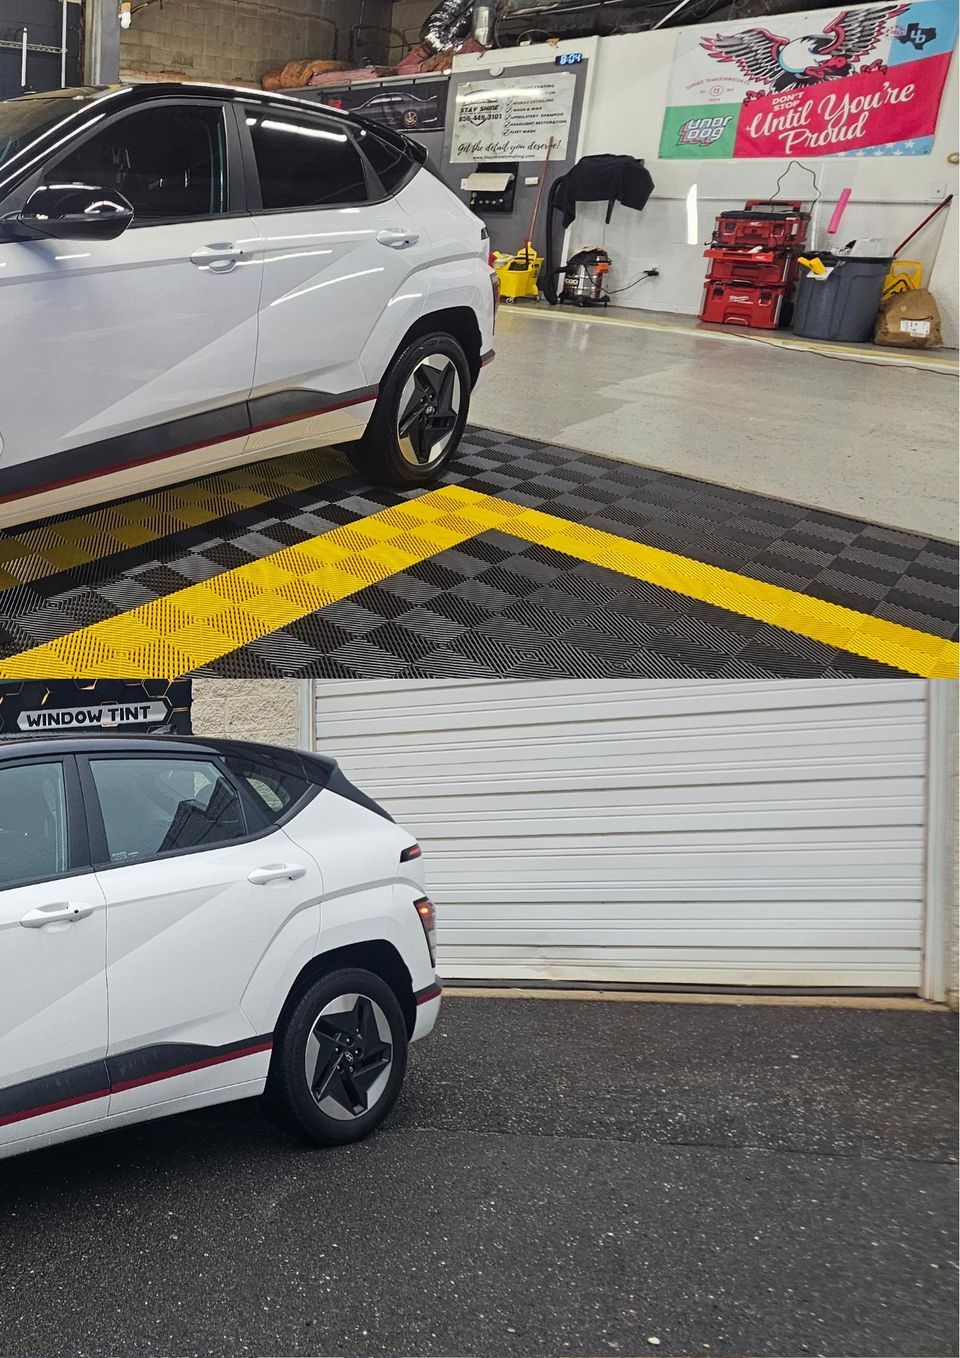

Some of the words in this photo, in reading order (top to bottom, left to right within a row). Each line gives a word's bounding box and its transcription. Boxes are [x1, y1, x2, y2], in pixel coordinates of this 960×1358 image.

[746, 101, 813, 138] Until
[818, 82, 916, 128] You're
[772, 92, 804, 106] DON'T
[773, 100, 800, 112] STOP
[778, 112, 867, 154] Proud
[27, 710, 103, 727] WINDOW
[107, 705, 151, 722] TINT
